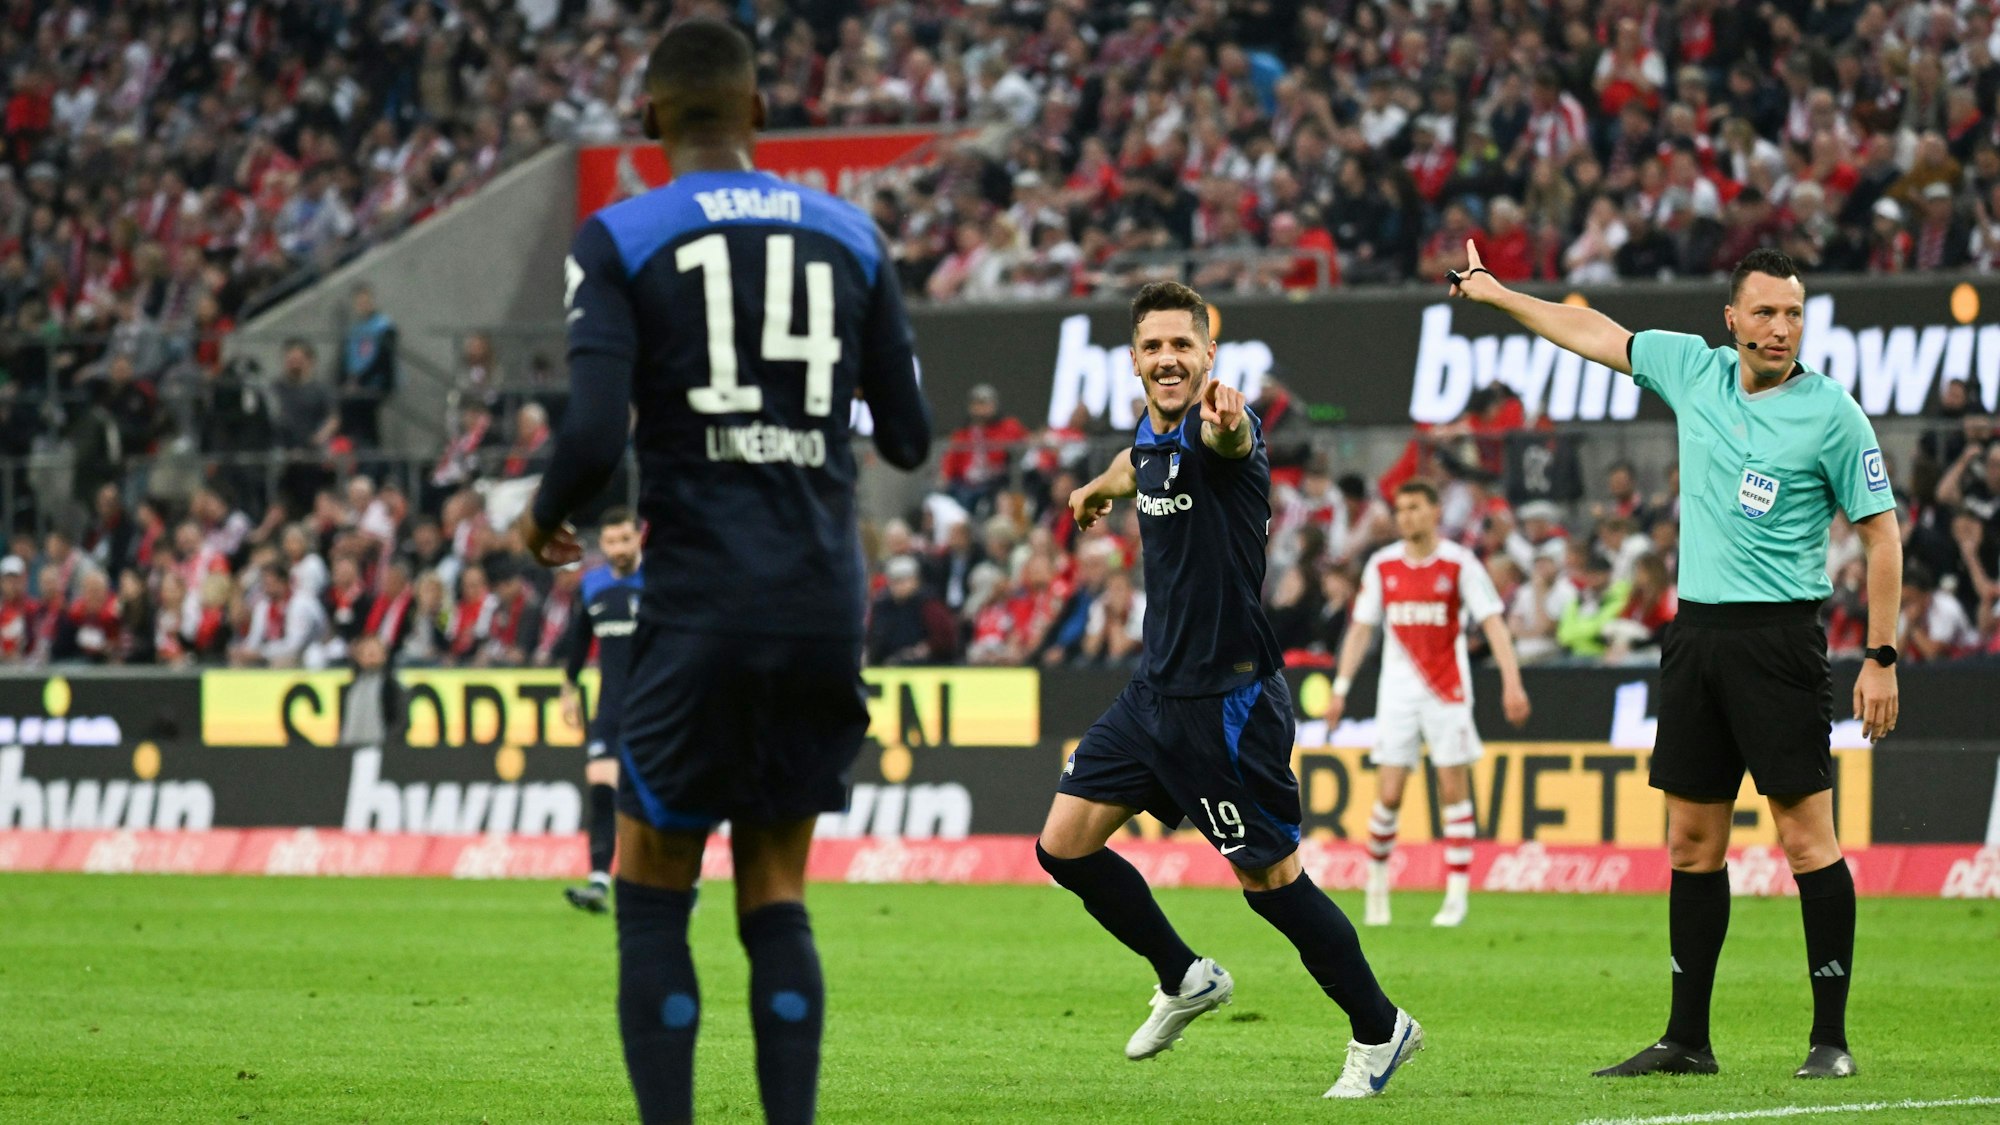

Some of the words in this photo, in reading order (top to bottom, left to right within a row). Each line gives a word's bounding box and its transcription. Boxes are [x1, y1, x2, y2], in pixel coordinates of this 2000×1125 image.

[675, 233, 841, 417] 14
[1741, 490, 1771, 506] REFEREE
[1745, 473, 1773, 493] FIFA
[343, 745, 583, 834] bwin
[1201, 798, 1246, 839] 19
[1484, 842, 1632, 892] DERTOUR
